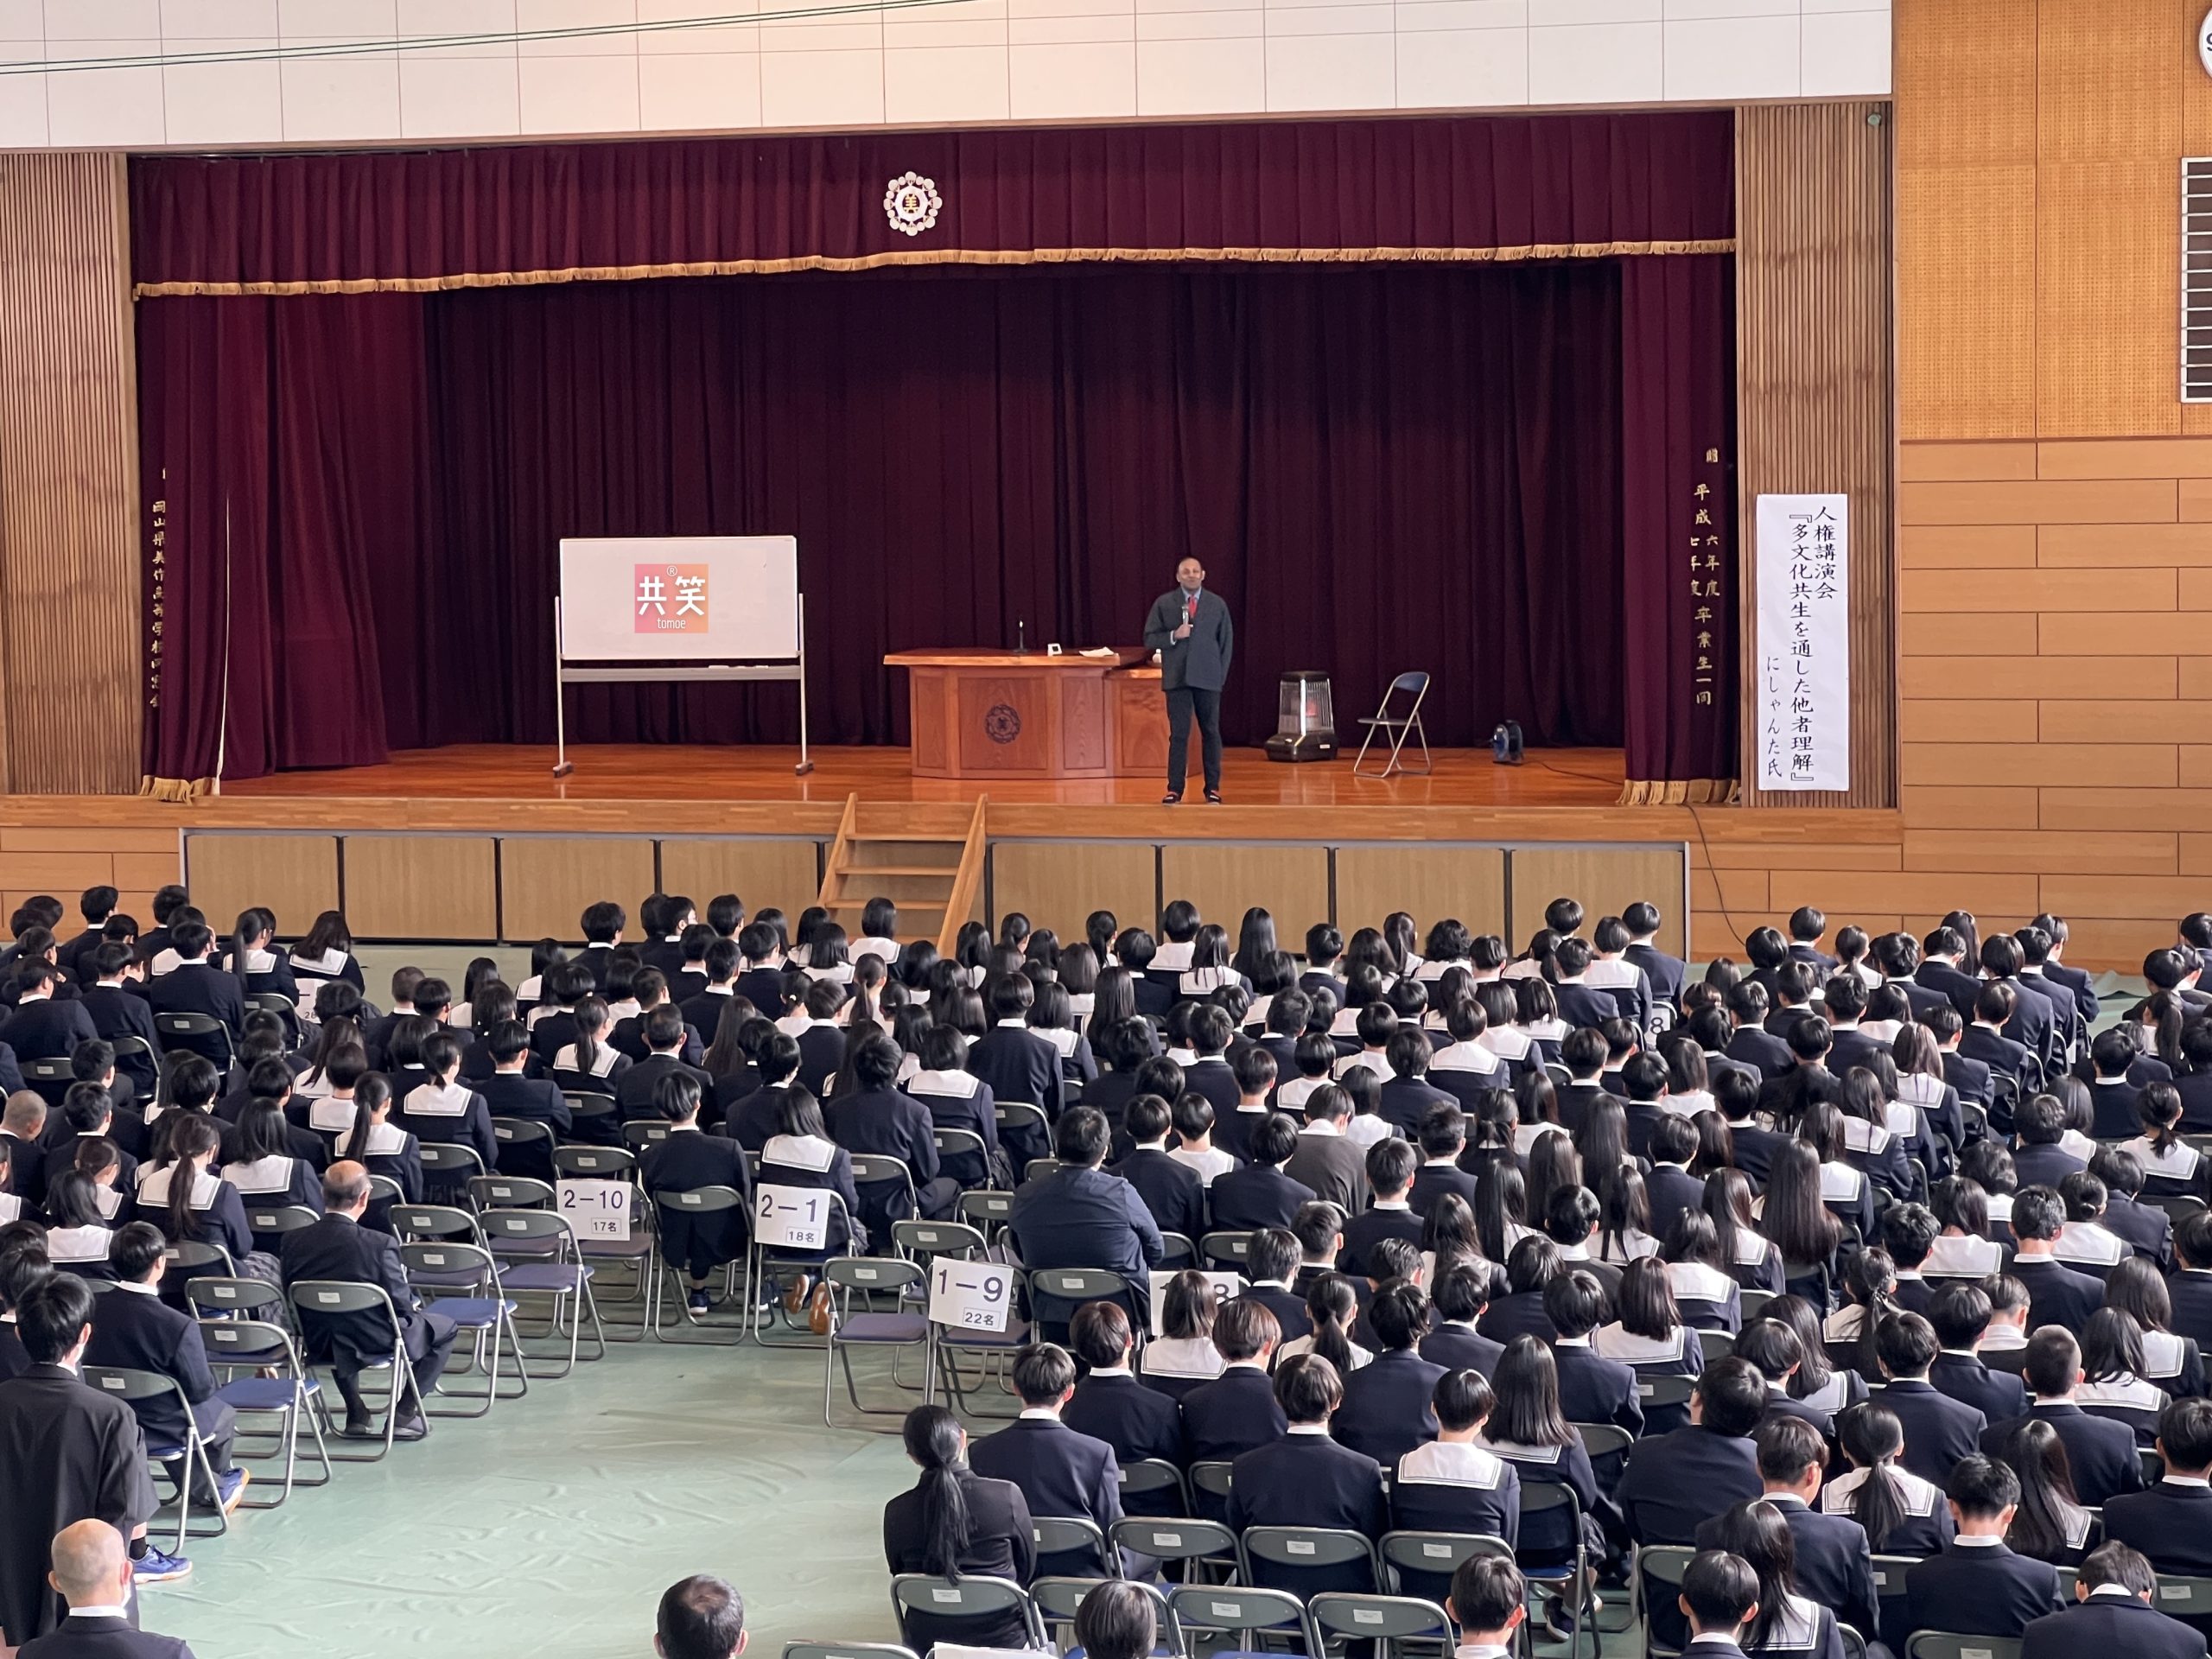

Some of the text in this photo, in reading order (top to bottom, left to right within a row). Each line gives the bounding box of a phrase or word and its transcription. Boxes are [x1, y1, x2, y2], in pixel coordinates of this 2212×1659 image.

[1815, 505, 1838, 600] 人権講演会
[637, 575, 706, 616] 共笑
[657, 617, 686, 629] tomoe
[1789, 514, 1815, 782] 『多文化共生を通した他者理解』
[1767, 656, 1783, 778] にしゃんた氏
[594, 1221, 617, 1232] 17名
[789, 1230, 814, 1243] 18名
[964, 1312, 994, 1326] 22名
